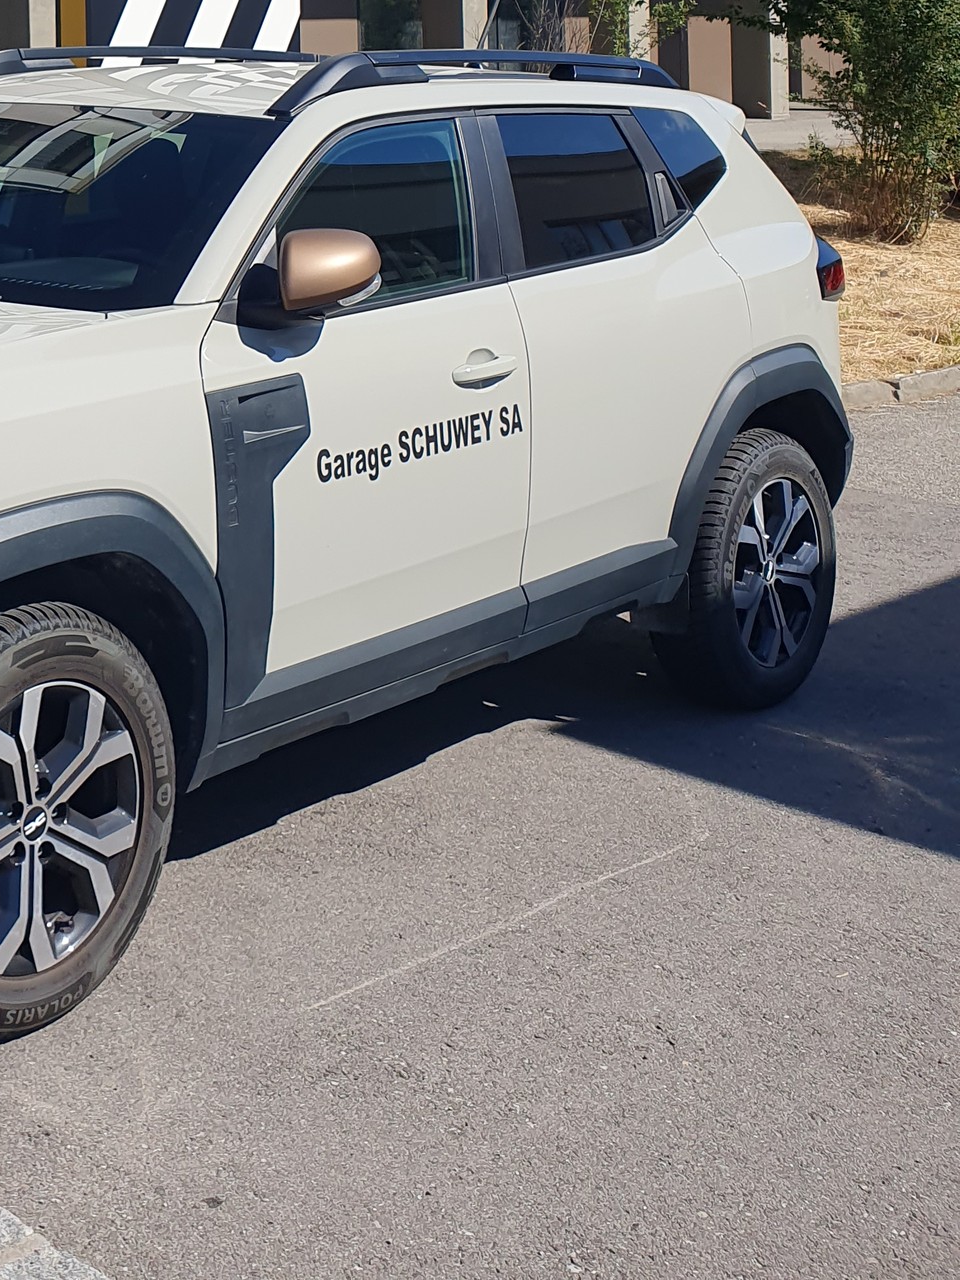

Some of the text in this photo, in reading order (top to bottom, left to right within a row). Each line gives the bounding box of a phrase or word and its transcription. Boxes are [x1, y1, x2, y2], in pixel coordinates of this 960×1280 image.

[316, 404, 523, 483] Garage SCHUWEY SA
[4, 984, 84, 1025] POLARIS
